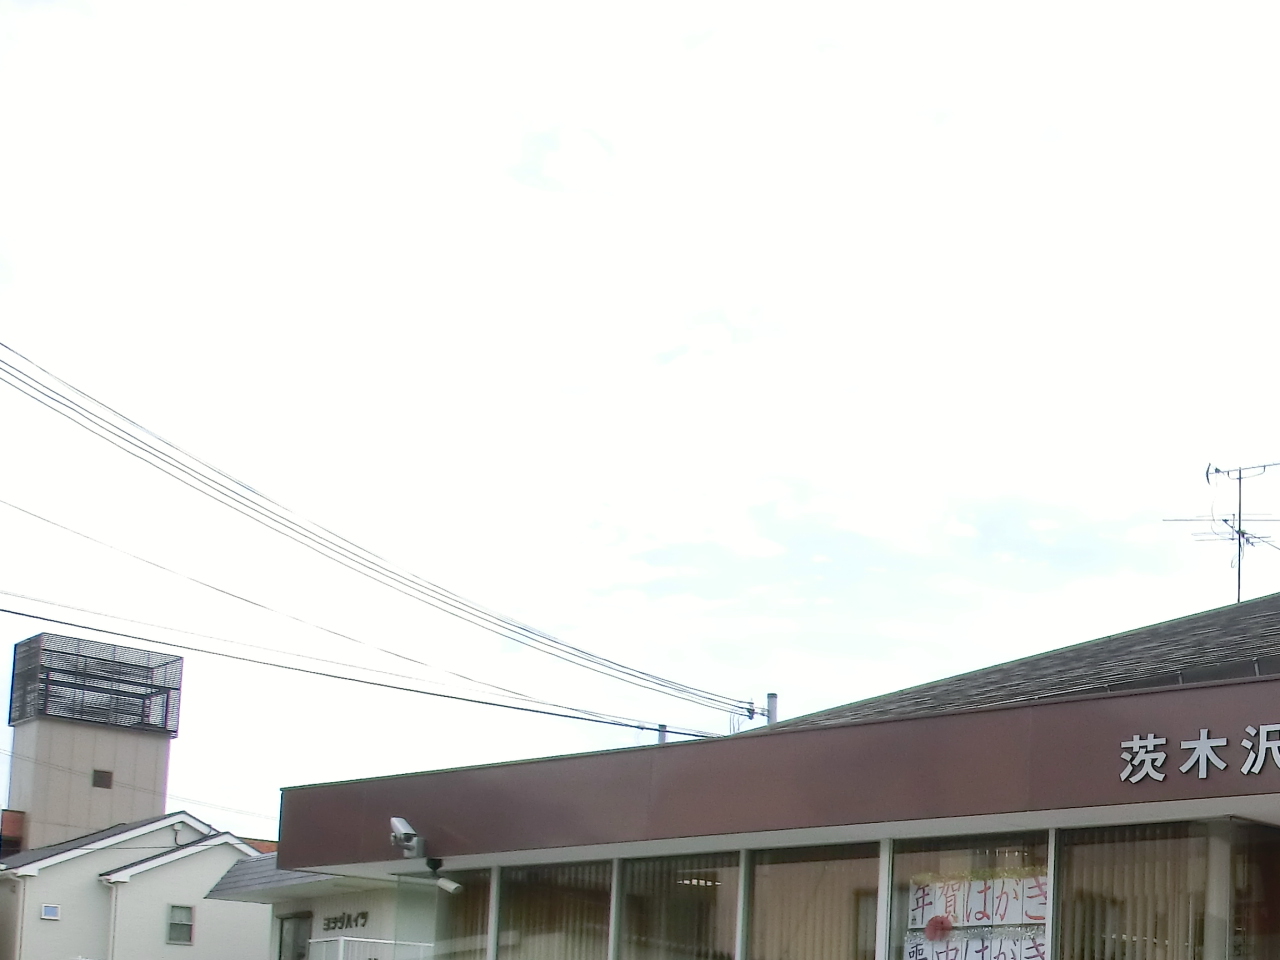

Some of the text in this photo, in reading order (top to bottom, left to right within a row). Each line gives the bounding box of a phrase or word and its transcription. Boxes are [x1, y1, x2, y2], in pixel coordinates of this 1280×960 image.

[911, 877, 1047, 925] 年賀はがき
